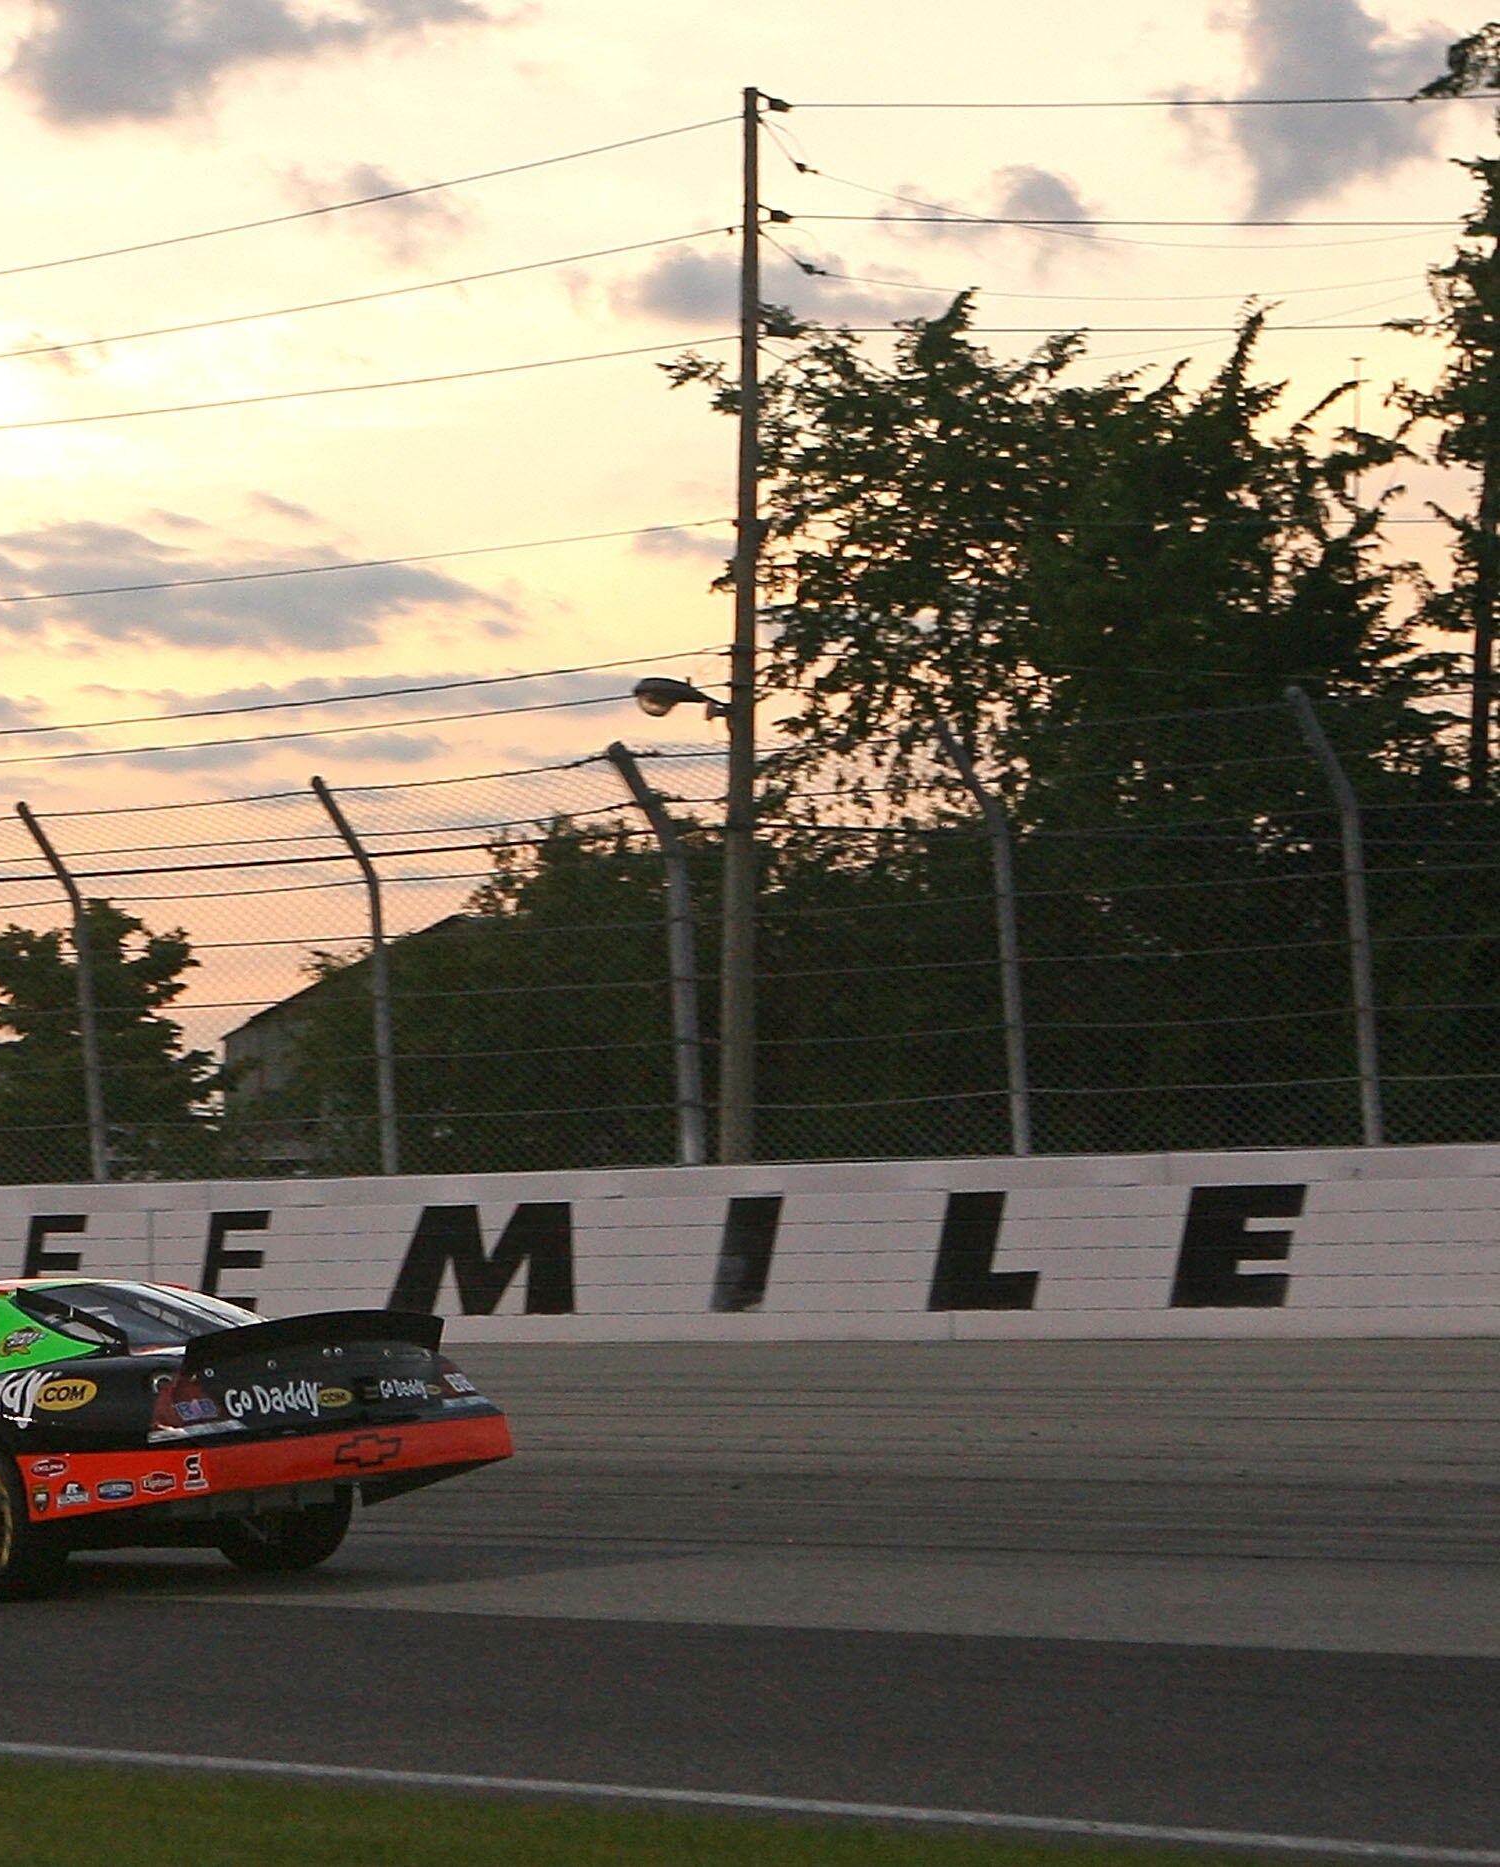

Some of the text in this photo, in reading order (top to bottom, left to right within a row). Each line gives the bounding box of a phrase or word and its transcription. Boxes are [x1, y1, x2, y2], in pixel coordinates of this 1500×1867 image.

[387, 1184, 1307, 1315] MILE
[225, 1389, 252, 1418] Go
[253, 1380, 321, 1417] Daddy
